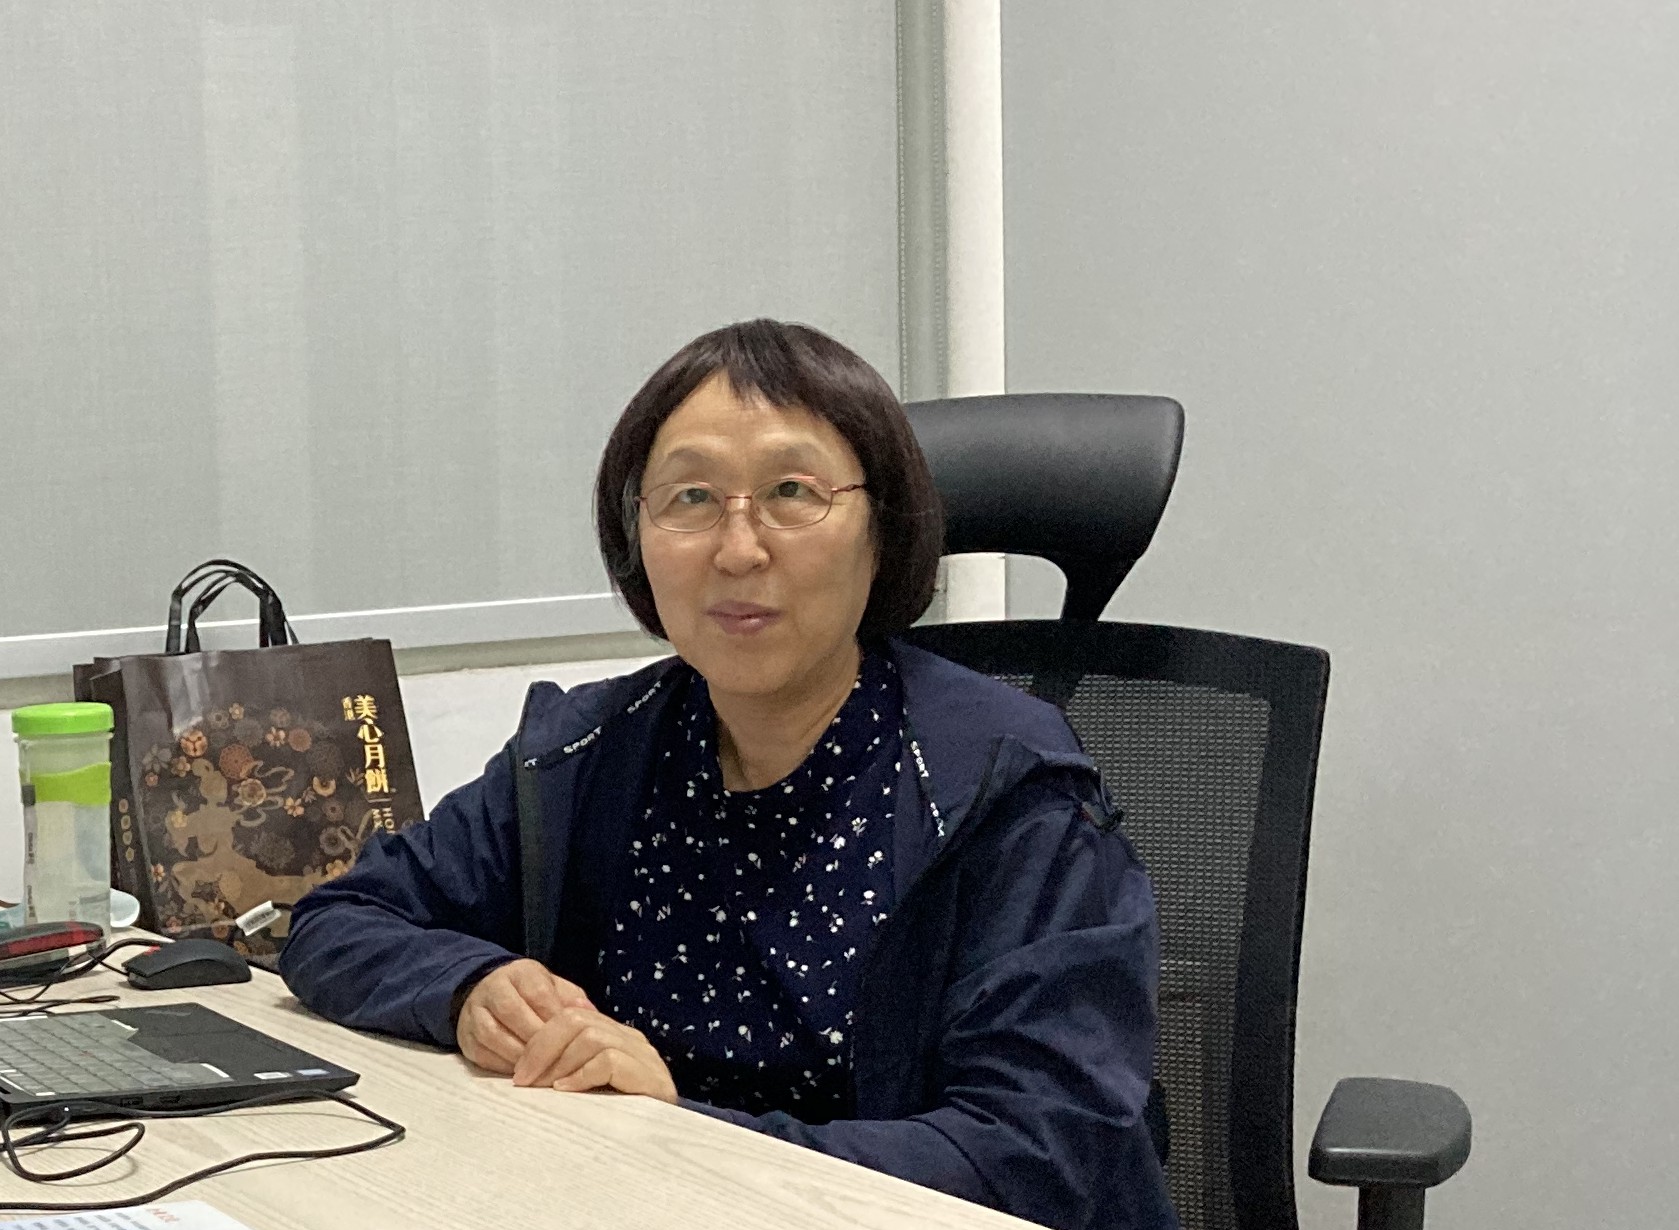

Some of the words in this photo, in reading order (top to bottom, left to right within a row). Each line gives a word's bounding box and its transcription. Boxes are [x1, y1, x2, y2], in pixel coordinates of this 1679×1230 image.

[626, 680, 662, 714] SPORT
[353, 694, 390, 793] 美心月餅
[563, 725, 602, 754] SPORT
[910, 740, 930, 778] SPORT
